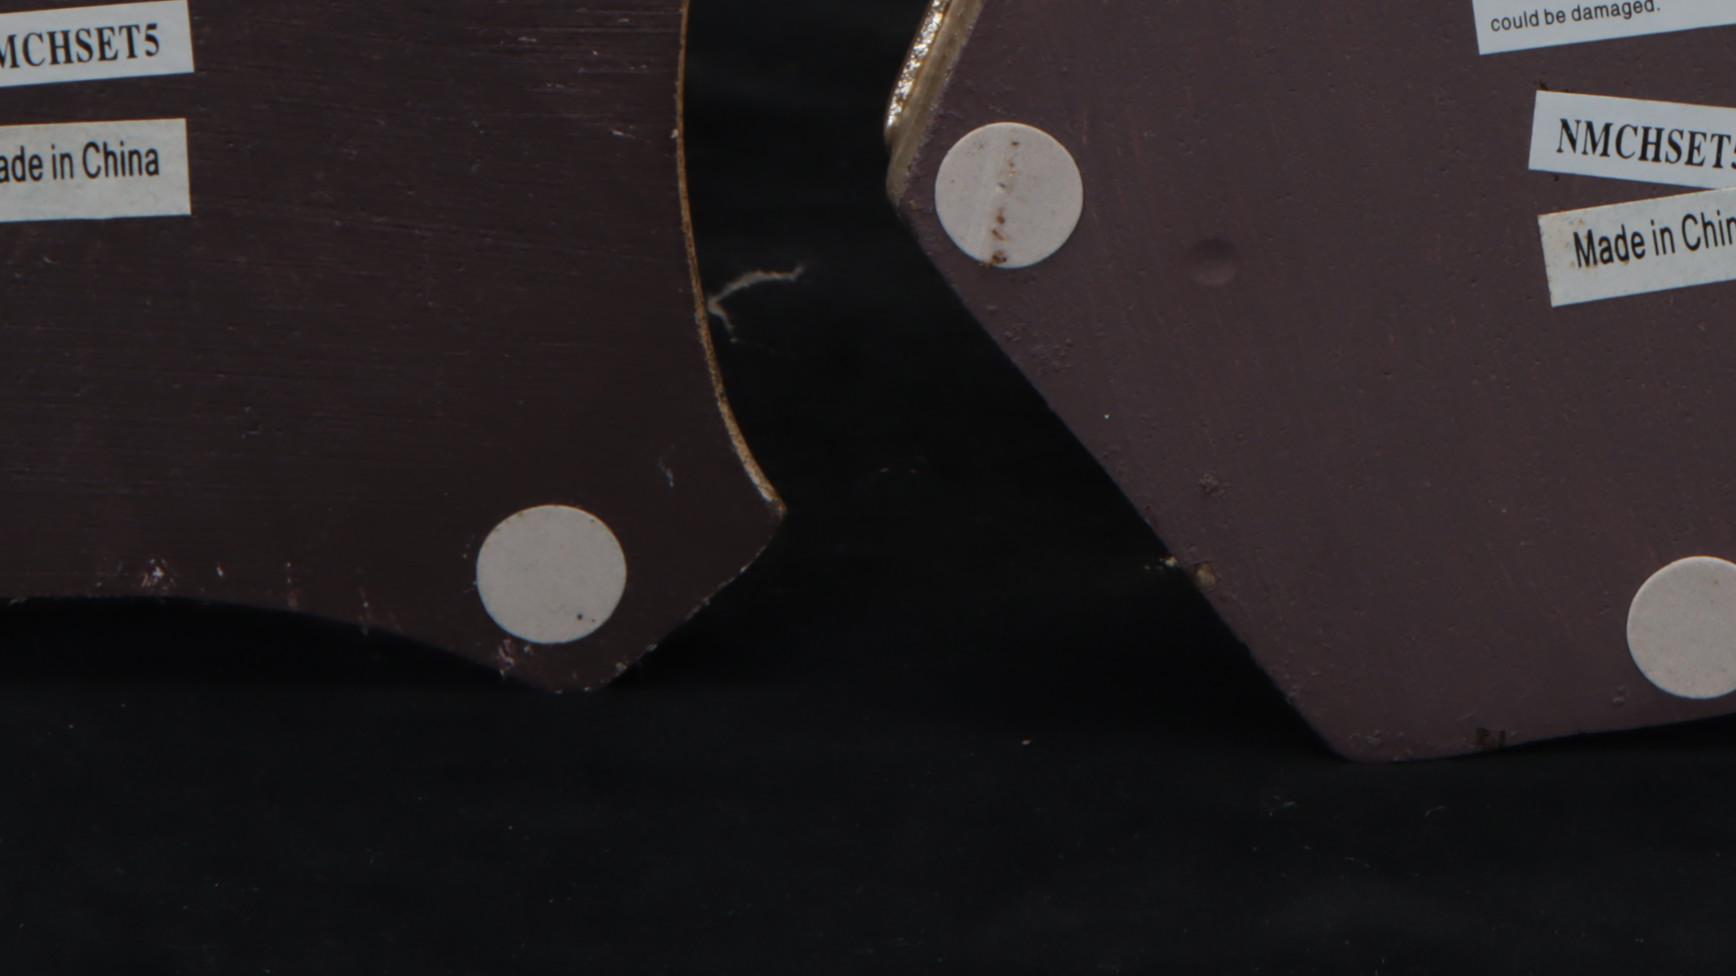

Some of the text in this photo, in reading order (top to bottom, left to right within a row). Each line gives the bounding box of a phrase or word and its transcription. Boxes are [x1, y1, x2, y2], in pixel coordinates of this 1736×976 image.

[1490, 11, 1540, 33] could
[1543, 7, 1566, 27] be
[50, 144, 74, 180] in
[82, 140, 160, 180] China
[1572, 224, 1646, 269] Made
[1650, 219, 1675, 257] in
